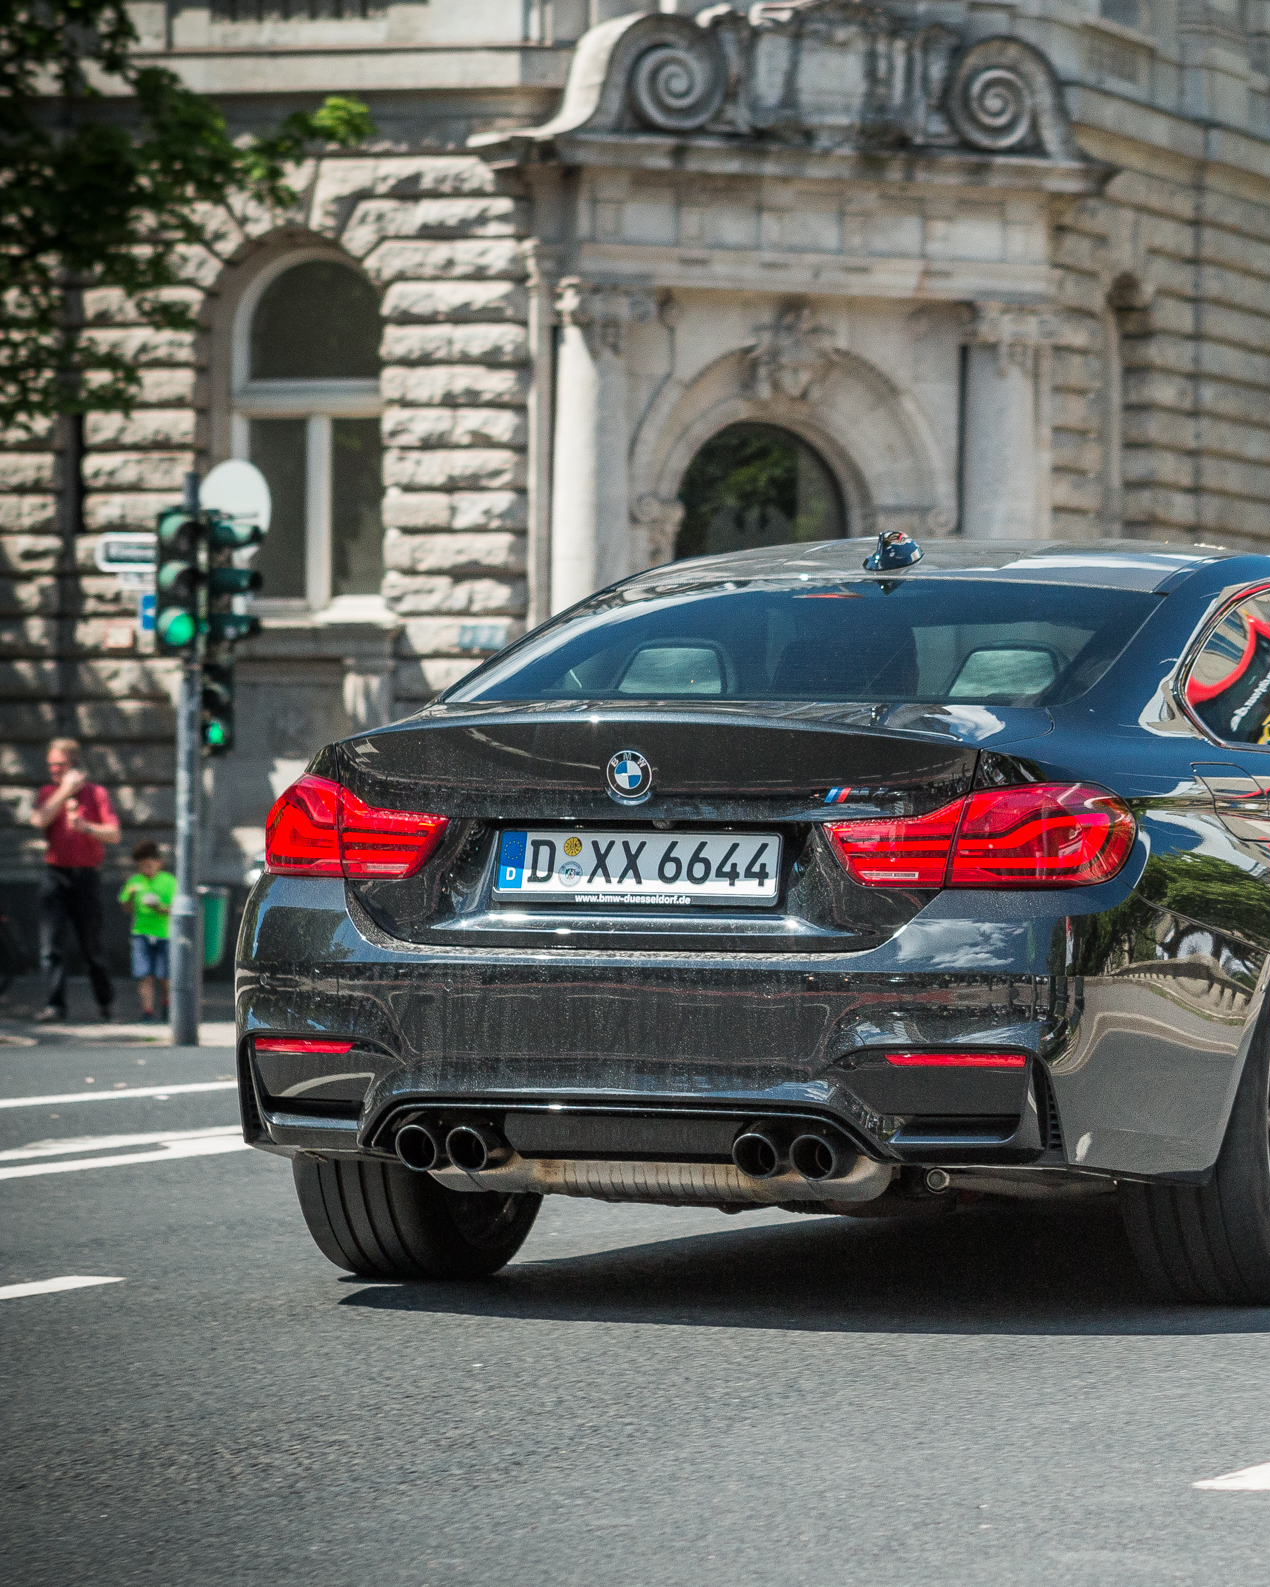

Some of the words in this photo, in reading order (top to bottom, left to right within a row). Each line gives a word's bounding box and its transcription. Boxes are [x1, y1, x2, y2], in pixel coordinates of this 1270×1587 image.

[610, 752, 647, 768] BMW
[527, 839, 557, 883] D
[587, 840, 647, 884] XX
[657, 840, 770, 887] 6644
[505, 866, 517, 881] D
[574, 893, 691, 905] www.bmw-duesseldorf.de
